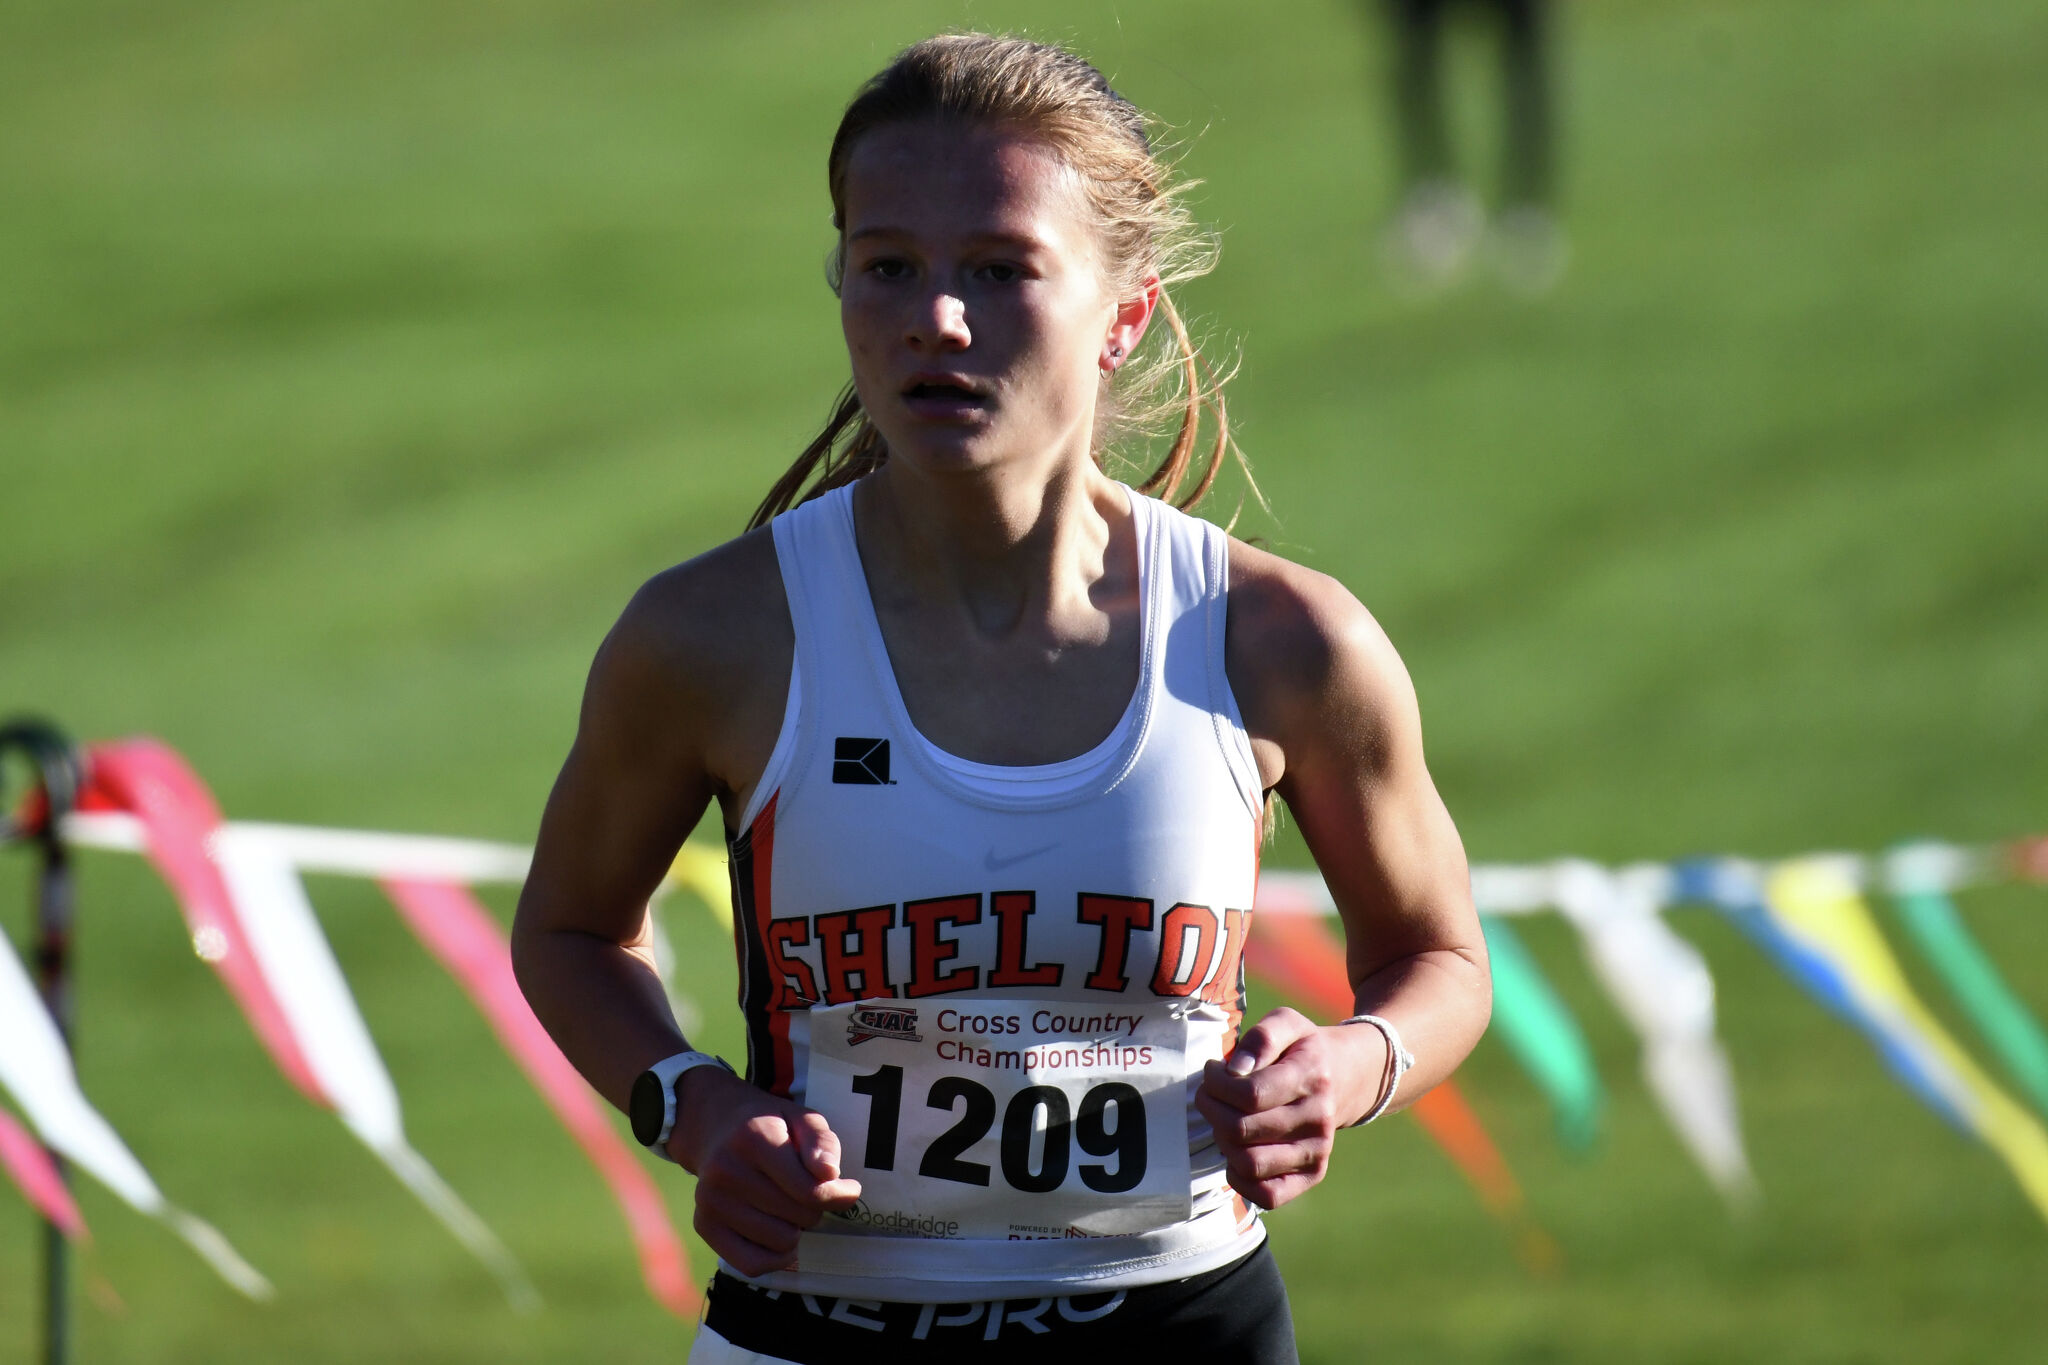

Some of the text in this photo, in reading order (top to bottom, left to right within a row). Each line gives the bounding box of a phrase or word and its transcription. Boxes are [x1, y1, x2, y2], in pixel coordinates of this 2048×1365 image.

[861, 1011, 919, 1032] CIAC
[937, 1009, 1020, 1034] Cross
[1032, 1010, 1144, 1036] Country
[936, 1041, 1153, 1075] Championships
[852, 1064, 1147, 1193] 1209
[1009, 1223, 1049, 1234] POWERED
